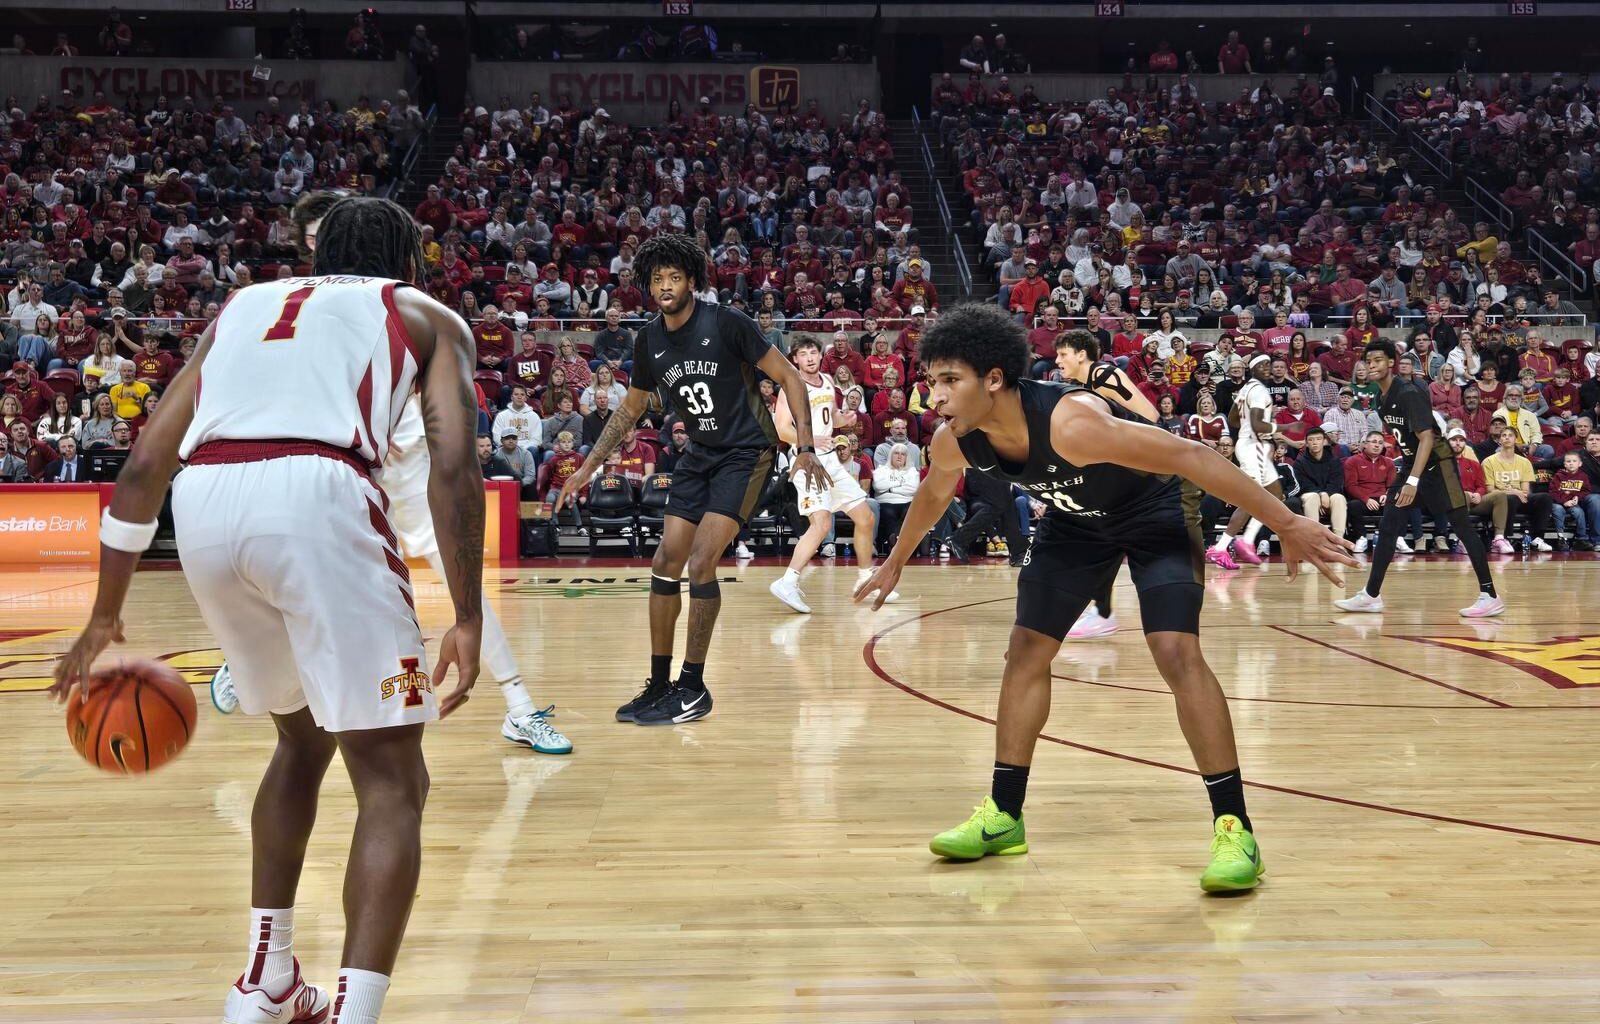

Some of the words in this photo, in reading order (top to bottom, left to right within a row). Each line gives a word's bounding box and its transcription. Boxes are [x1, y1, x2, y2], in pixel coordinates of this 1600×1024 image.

[228, 0, 253, 9] 132
[666, 3, 690, 14] 133
[1098, 3, 1121, 15] 134
[1511, 3, 1534, 14] 135
[549, 72, 747, 105] CYCLONES
[260, 286, 318, 342] 1
[518, 361, 540, 375] ISU
[661, 364, 683, 387] LONG
[684, 361, 718, 376] BEACH
[679, 382, 714, 415] 33
[822, 406, 830, 425] 0
[48, 515, 89, 532] Bank
[380, 671, 433, 700] STATE
